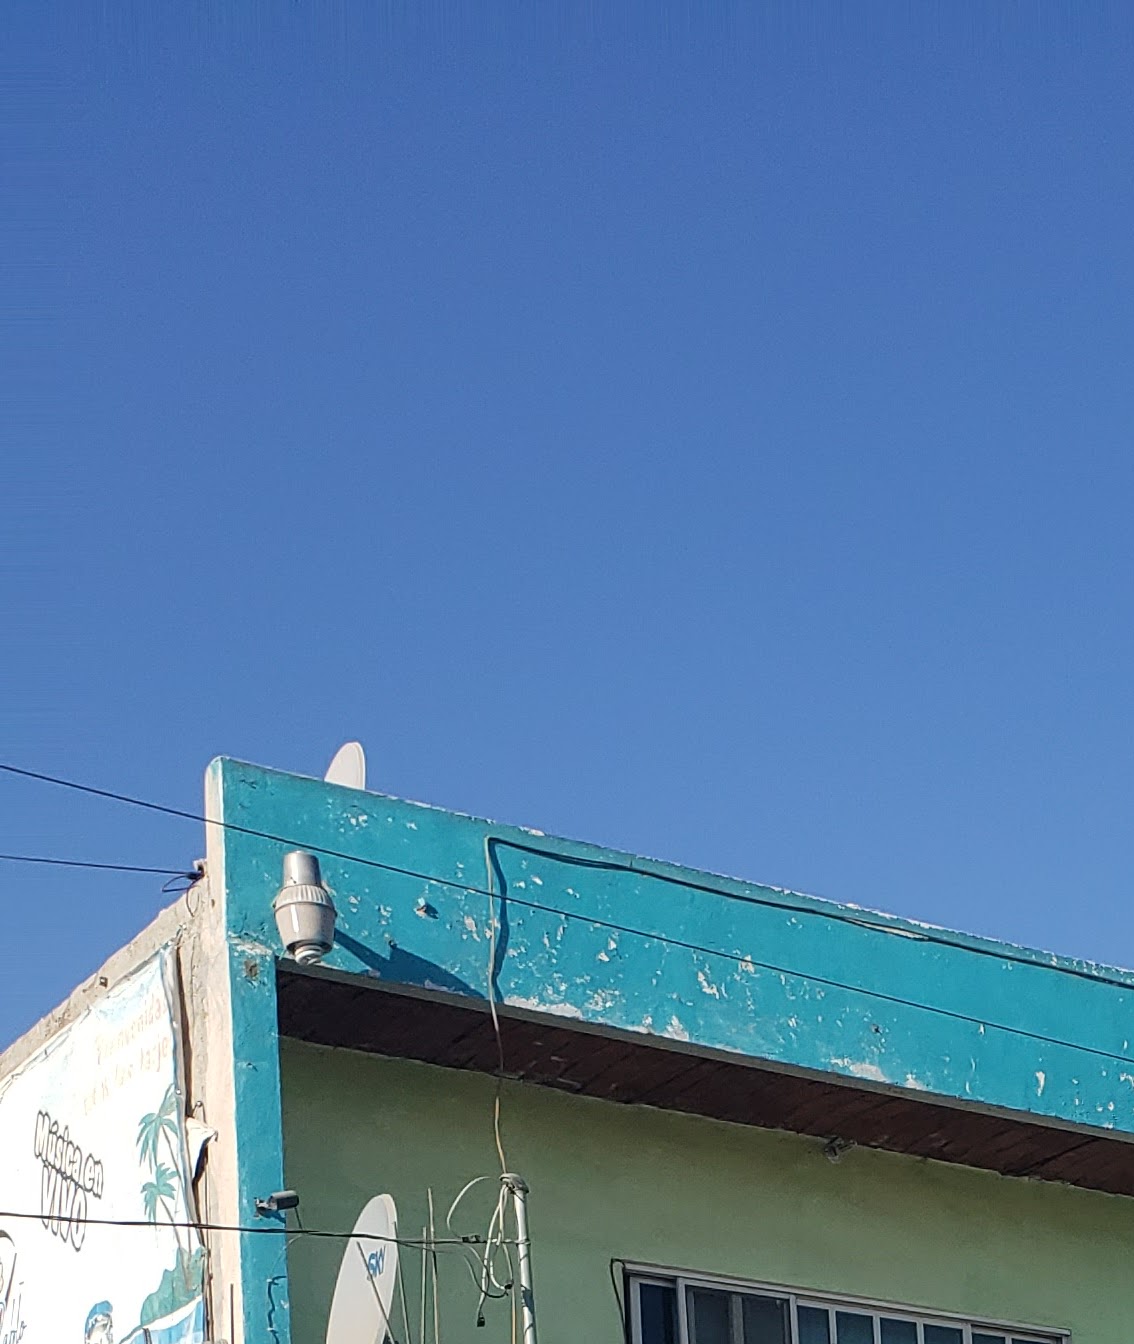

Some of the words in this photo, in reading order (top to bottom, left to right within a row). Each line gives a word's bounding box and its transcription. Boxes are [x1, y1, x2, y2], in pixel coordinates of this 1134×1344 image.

[34, 1109, 83, 1190] Música
[83, 1152, 104, 1200] en
[368, 1244, 386, 1278] SKY
